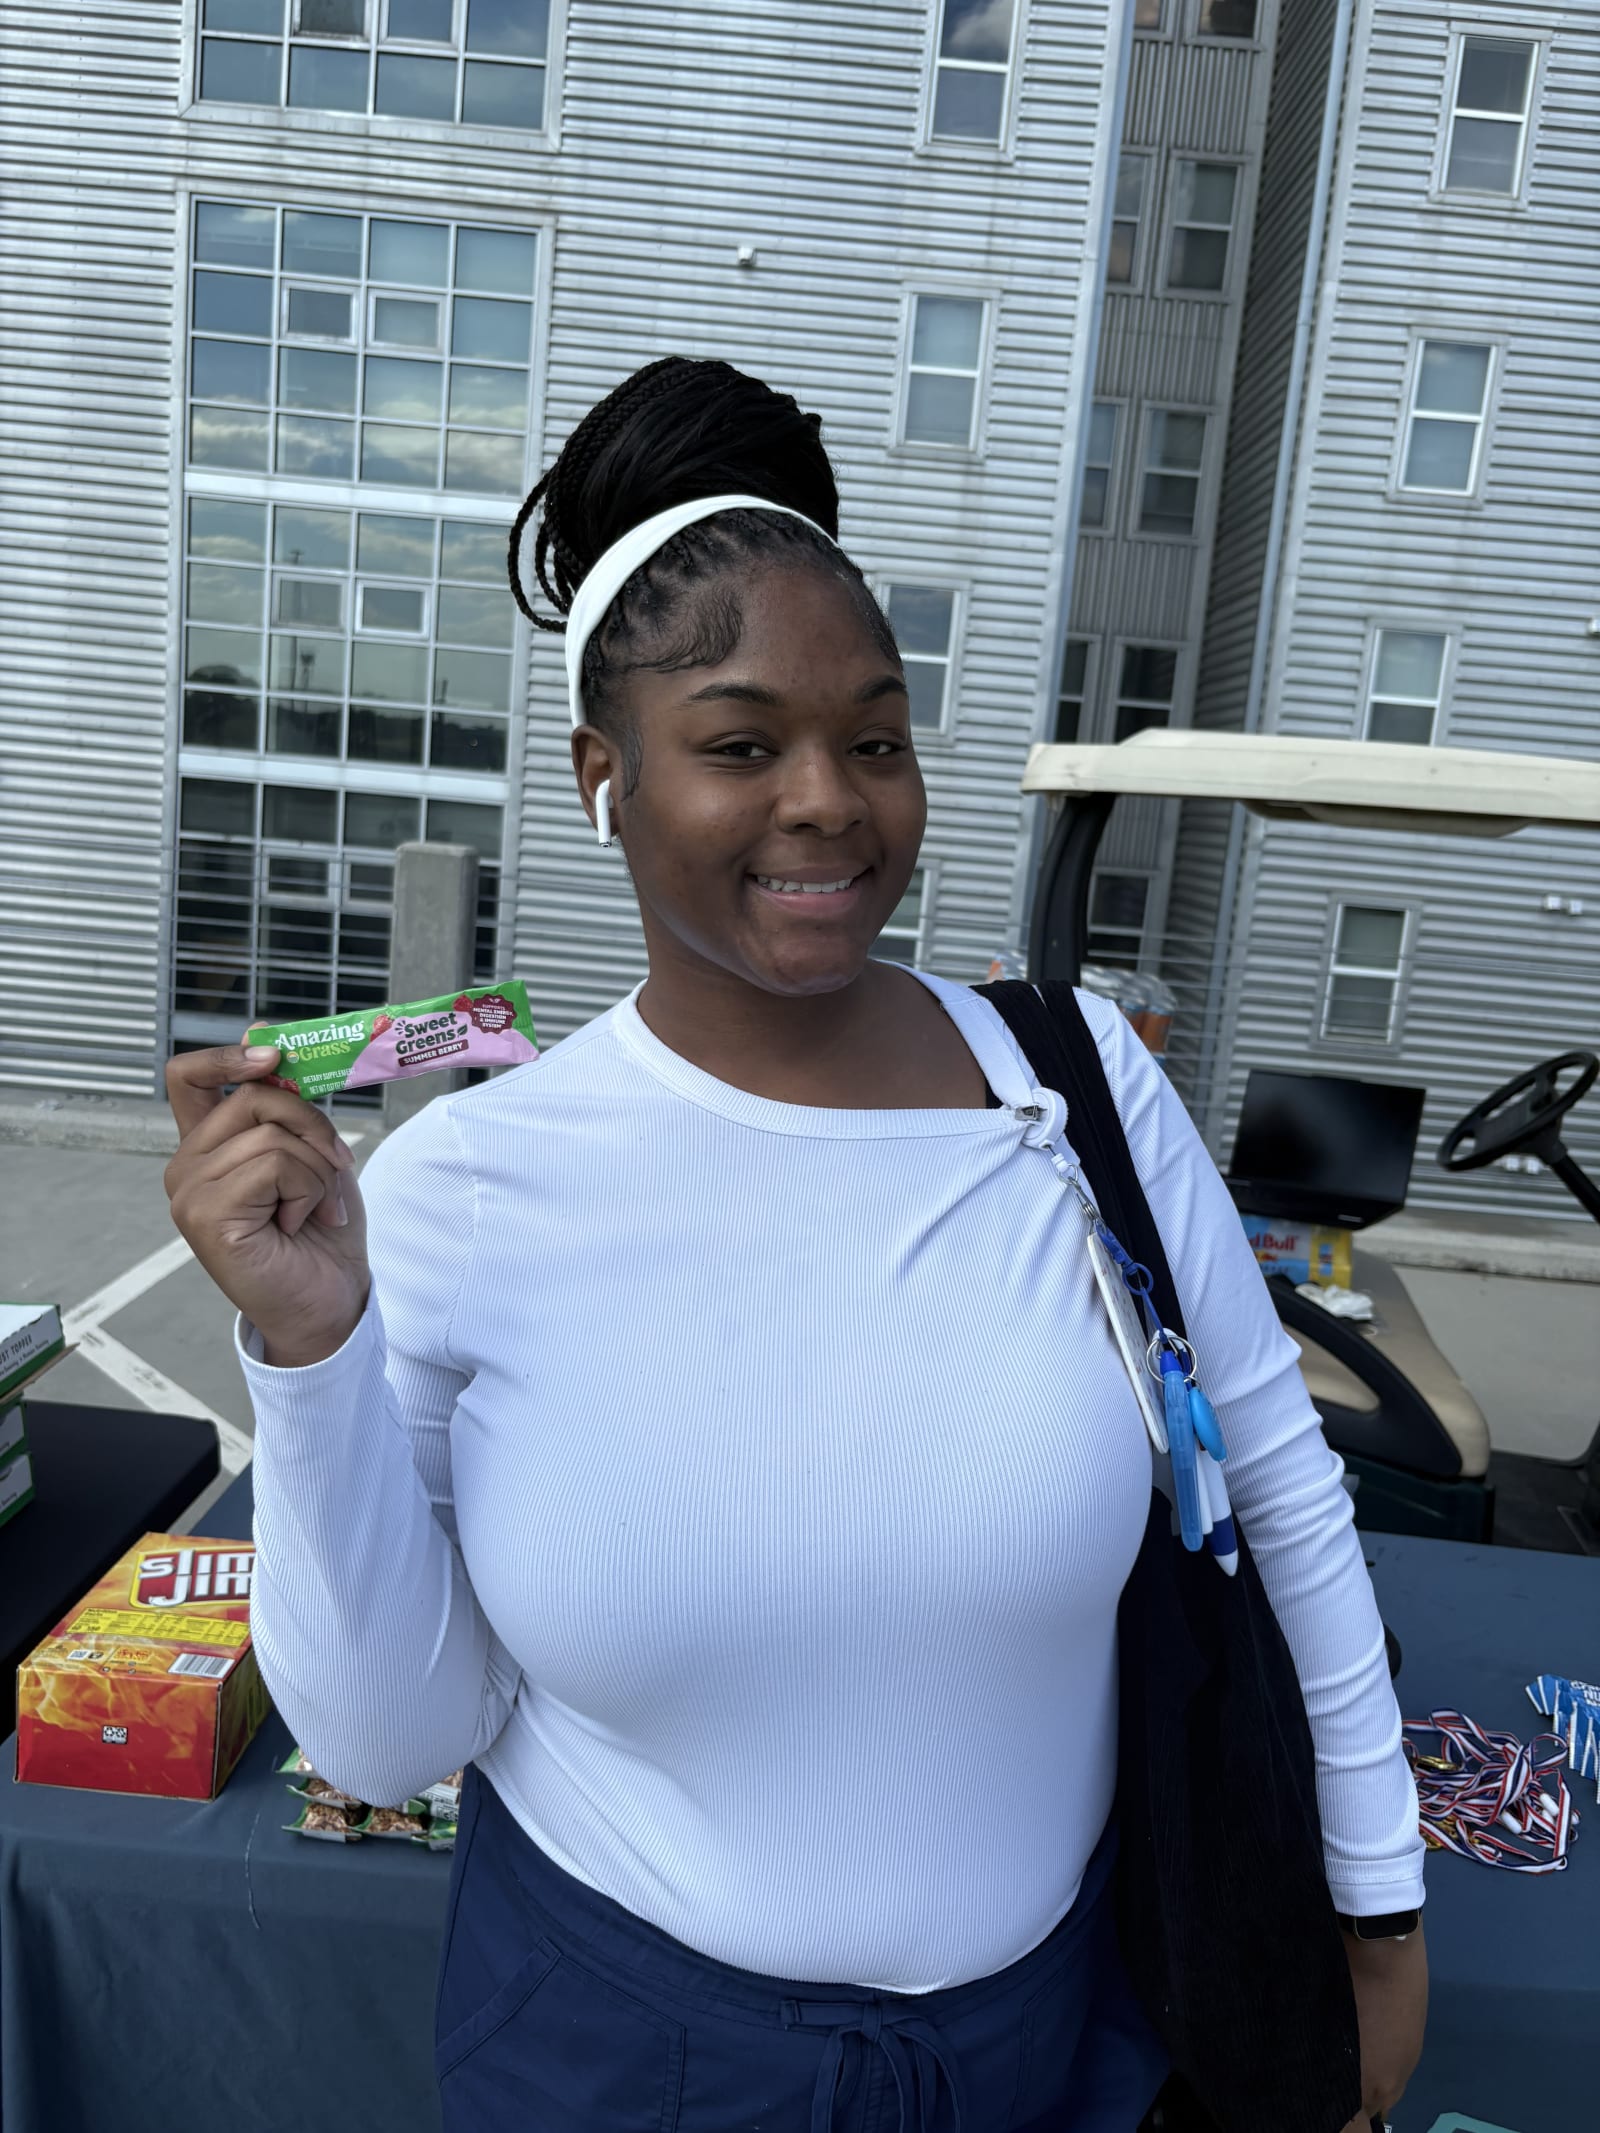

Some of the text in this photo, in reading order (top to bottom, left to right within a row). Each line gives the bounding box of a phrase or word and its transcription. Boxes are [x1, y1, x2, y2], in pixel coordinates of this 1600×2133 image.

[275, 1020, 365, 1051] Amazing
[404, 1012, 458, 1038] Sweet
[299, 1040, 351, 1061] Grass
[395, 1028, 456, 1055] Greens
[403, 1050, 438, 1064] SUMMER
[438, 1042, 464, 1056] BERRY
[303, 1074, 323, 1084] DIETARY
[1263, 1233, 1295, 1251] Bull
